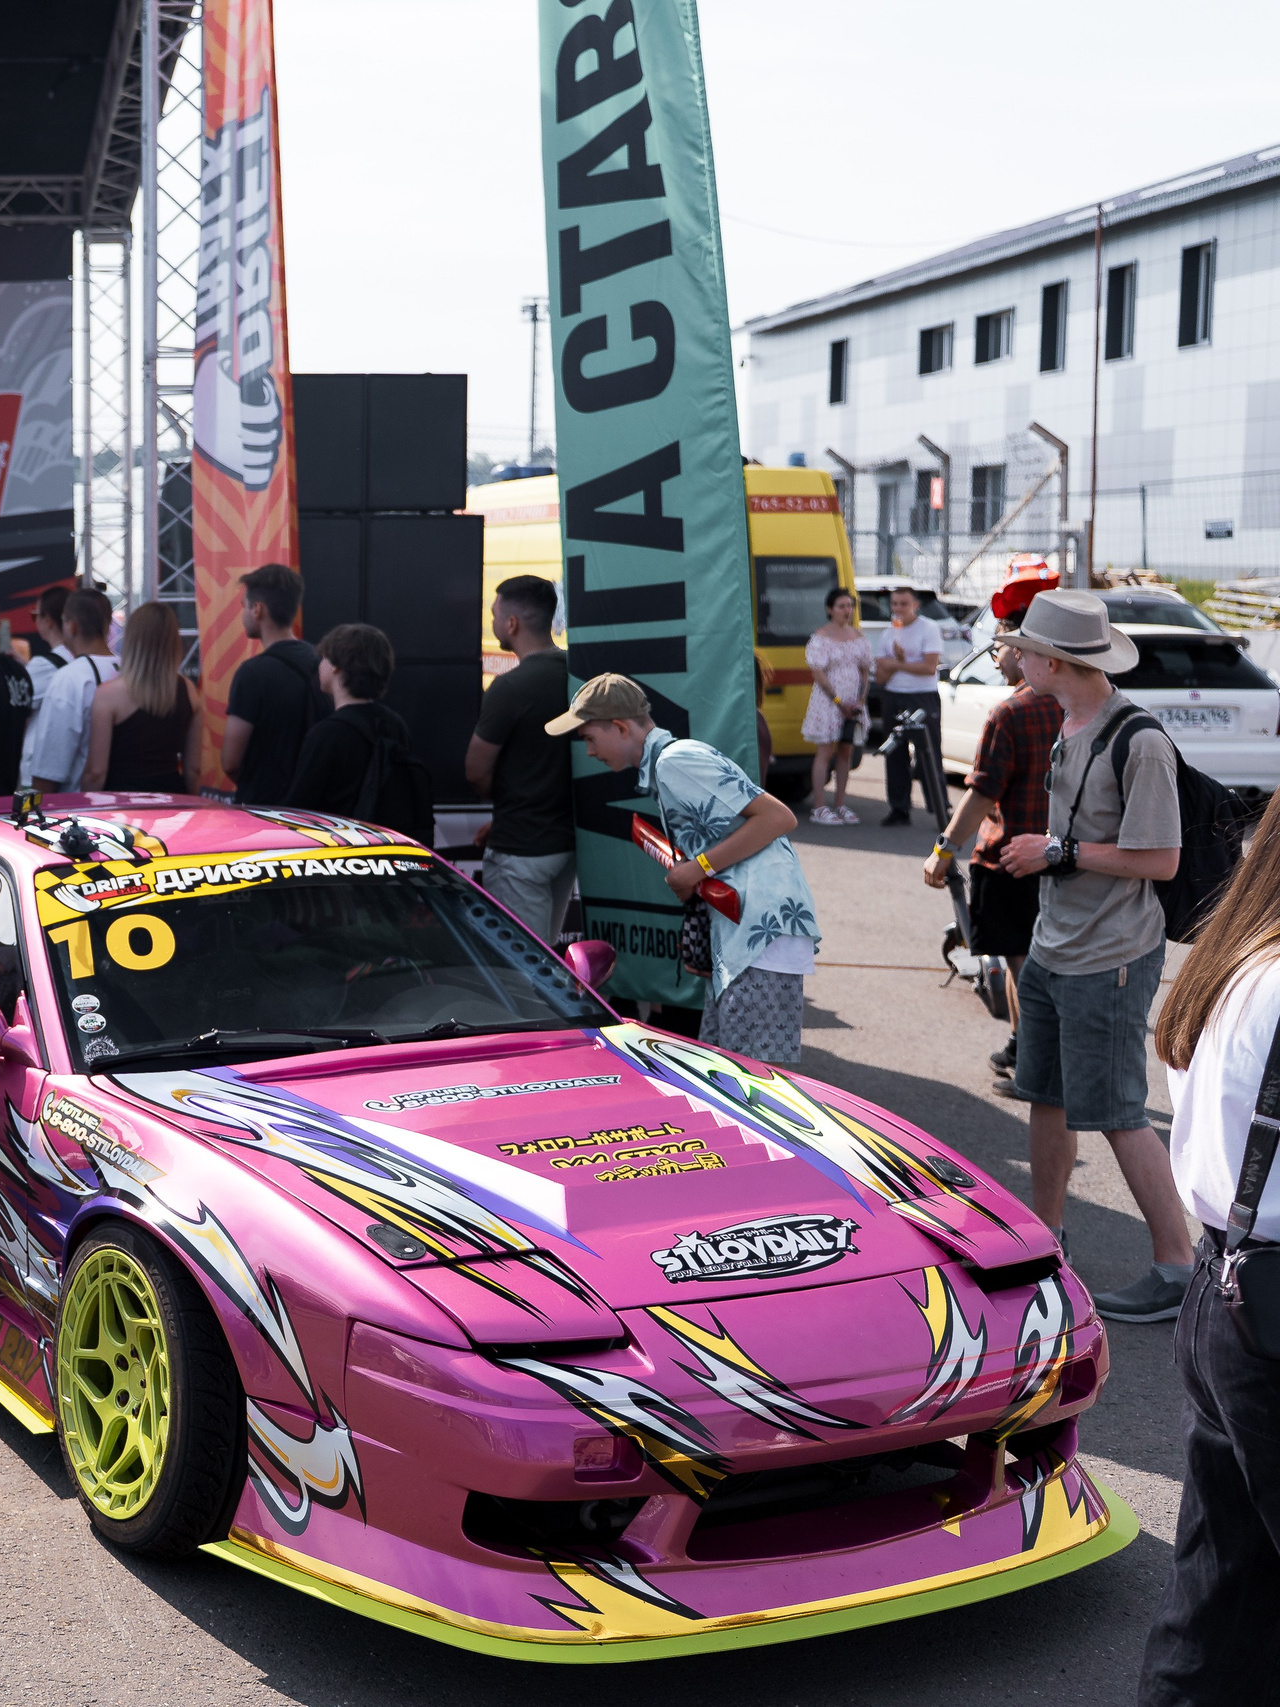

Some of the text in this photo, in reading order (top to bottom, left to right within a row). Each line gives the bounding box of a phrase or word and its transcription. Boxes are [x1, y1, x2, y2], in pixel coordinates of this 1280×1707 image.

[555, 0, 676, 414] СТАВ
[80, 873, 144, 896] DRIFT
[155, 861, 280, 893] ДРИФТ
[281, 858, 397, 877] ТАКСИ
[47, 913, 176, 980] 10
[651, 1226, 848, 1274] STILOVDAILY
